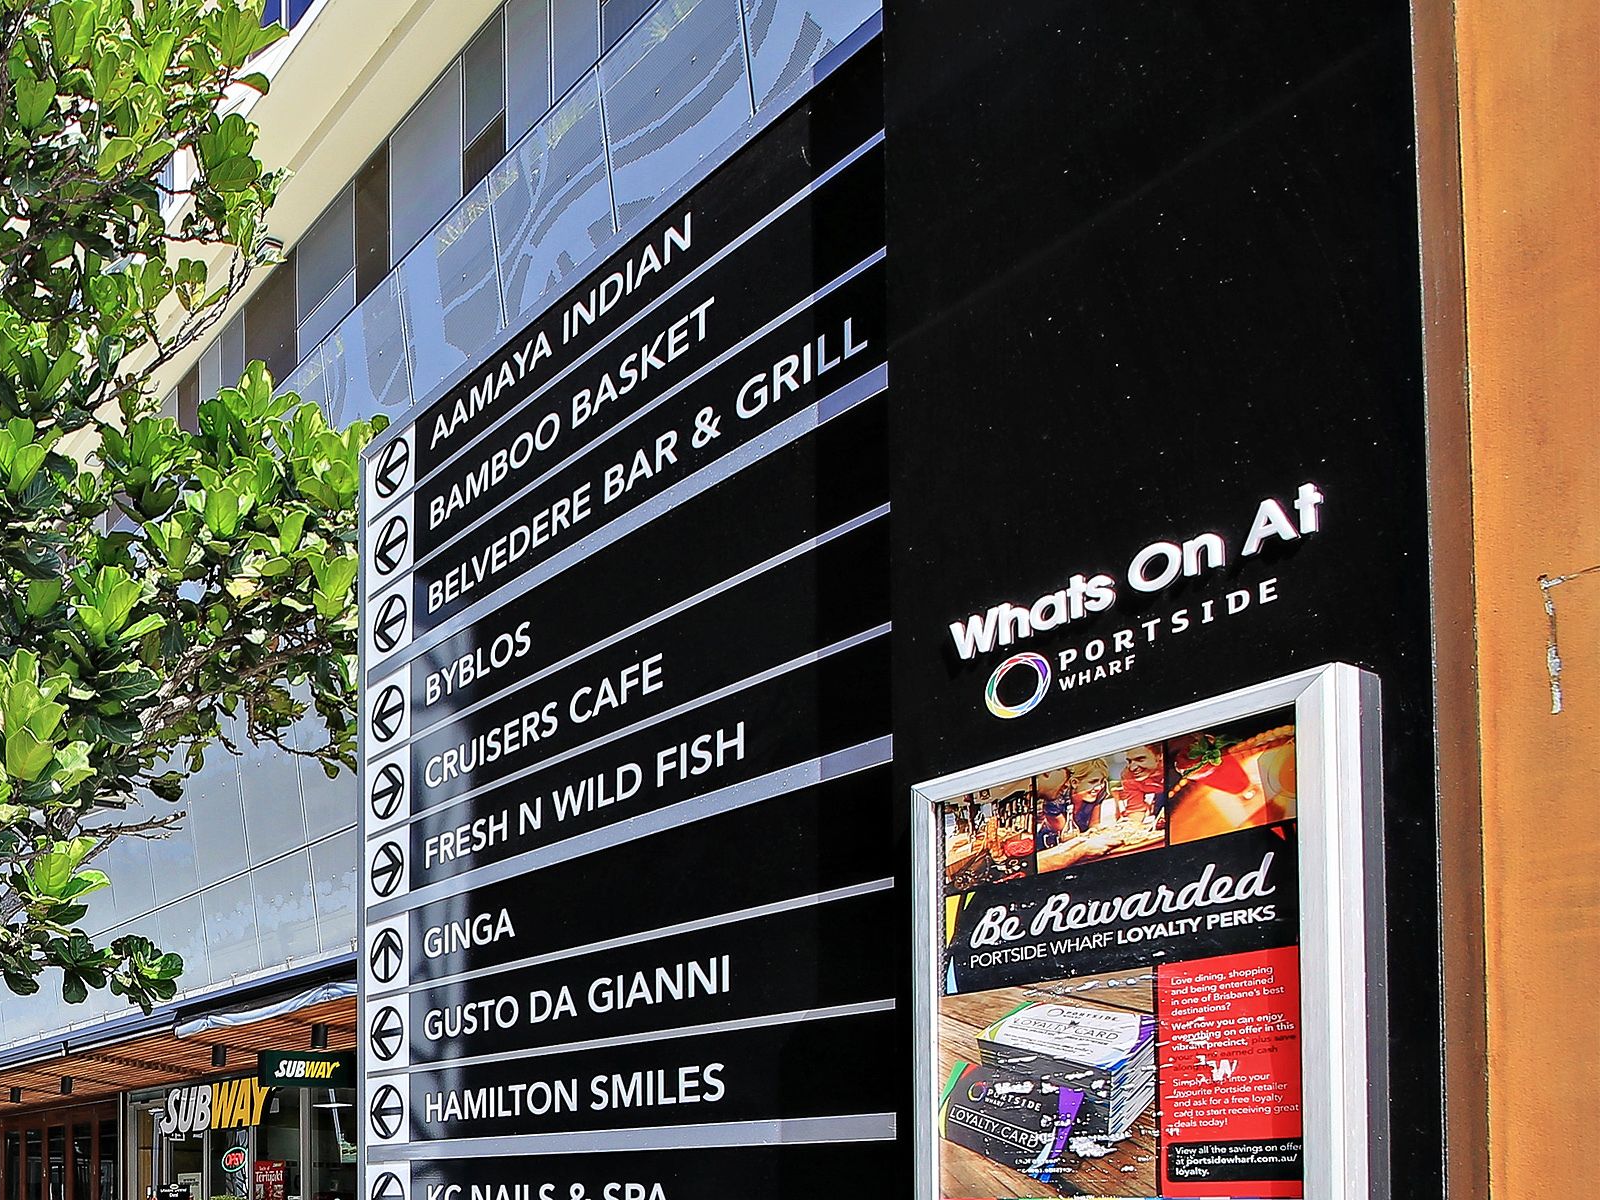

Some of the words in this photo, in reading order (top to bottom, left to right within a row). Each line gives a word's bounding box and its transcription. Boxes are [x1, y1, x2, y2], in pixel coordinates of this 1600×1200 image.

[430, 331, 552, 449] AAMAYA
[562, 213, 692, 344] INDIAN
[429, 413, 561, 530] BAMBOO
[572, 297, 715, 426] BASKET
[427, 483, 591, 615] BELVEDERE
[604, 431, 678, 504] BAR
[691, 405, 721, 449] &
[736, 318, 868, 420] GRILL
[949, 574, 1117, 660] Whats
[1127, 531, 1226, 592] On
[1241, 482, 1324, 556] At
[1058, 577, 1280, 670] PORTSIDE
[425, 621, 532, 706] BYBLOS
[1058, 654, 1137, 691] WHARF
[424, 702, 558, 788] CRUISERS
[569, 653, 663, 724] CAFE
[424, 810, 507, 868] FRESH
[519, 797, 542, 835] N
[552, 762, 642, 822] WILD
[656, 721, 745, 788] FISH
[970, 902, 1026, 948] Be
[1030, 851, 1276, 936] Rewarded
[423, 908, 515, 958] GINGA
[970, 944, 1047, 969] PORTSIDE
[1049, 931, 1113, 956] WHARF
[1117, 916, 1202, 945] LOYALTY
[1206, 904, 1276, 930] PERKS
[1171, 977, 1192, 986] Love
[1228, 966, 1273, 978] shopping
[1171, 986, 1188, 996] and
[1190, 982, 1217, 994] being
[1219, 976, 1274, 990] entertained
[423, 996, 519, 1040] GUSTO
[530, 985, 577, 1023] DA
[587, 954, 730, 1013] GIANNI
[1171, 997, 1179, 1006] in
[1201, 993, 1211, 1003] of
[1213, 988, 1261, 1001] Brisbane's
[1263, 986, 1285, 995] best
[1171, 1002, 1232, 1016] destinations?
[1193, 1021, 1215, 1029] now
[1216, 1018, 1234, 1029] you
[1256, 1013, 1284, 1024] enjoy
[1238, 1024, 1262, 1034] offer
[1264, 1022, 1274, 1031] in
[1276, 1020, 1295, 1030] this
[274, 1060, 340, 1078] SUBWAY
[1249, 1073, 1270, 1084] your
[425, 1078, 577, 1123] HAMILTON
[590, 1062, 725, 1111] SMILES
[1173, 1098, 1191, 1107] and
[1193, 1097, 1207, 1106] ask
[1209, 1096, 1222, 1104] for
[1231, 1094, 1249, 1103] free
[1252, 1093, 1283, 1103] loyalty
[1214, 1084, 1251, 1094] Portside
[1254, 1082, 1288, 1091] retailer
[160, 1076, 272, 1135] SUBWAY
[950, 1106, 995, 1131] LOYALTY
[1173, 1108, 1194, 1117] card
[1195, 1108, 1205, 1116] to
[1206, 1107, 1226, 1116] start
[1228, 1104, 1272, 1115] receiving
[1273, 1104, 1299, 1114] great
[1173, 1119, 1197, 1128] deals
[1199, 1118, 1228, 1128] today!
[1175, 1147, 1197, 1155] View
[1198, 1145, 1209, 1154] all
[1211, 1145, 1227, 1154] the
[1228, 1144, 1263, 1154] savings
[1264, 1144, 1278, 1152] on
[1175, 1167, 1210, 1177] loyalty.
